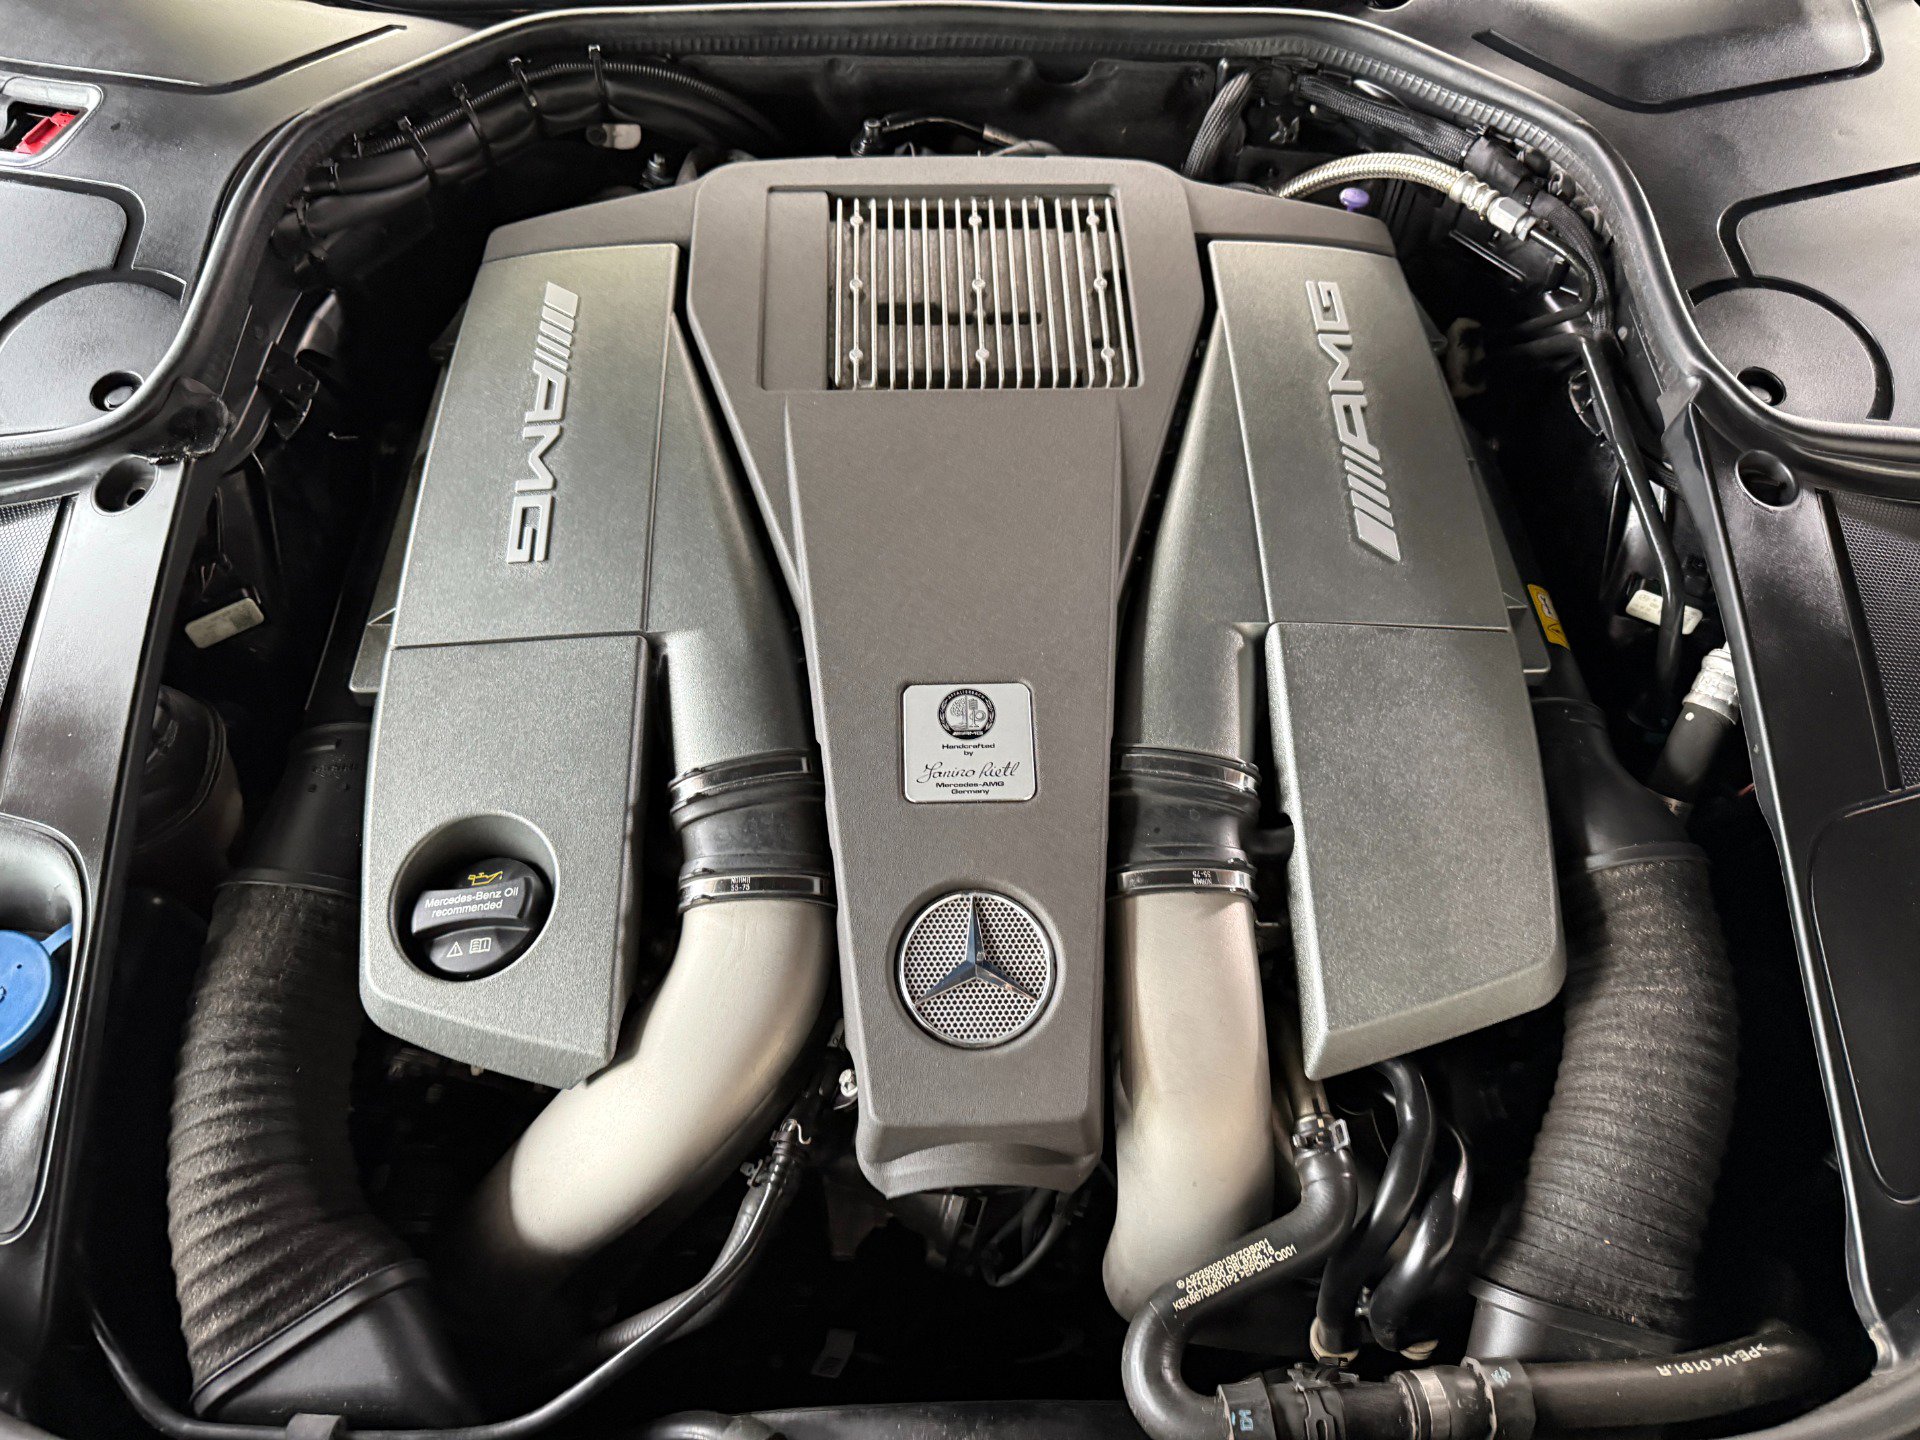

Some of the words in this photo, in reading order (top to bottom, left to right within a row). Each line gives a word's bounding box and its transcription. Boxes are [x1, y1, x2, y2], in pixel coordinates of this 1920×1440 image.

[424, 890, 502, 908] Mercedes-Benz
[504, 887, 519, 898] Oil
[431, 900, 503, 918] recommended
